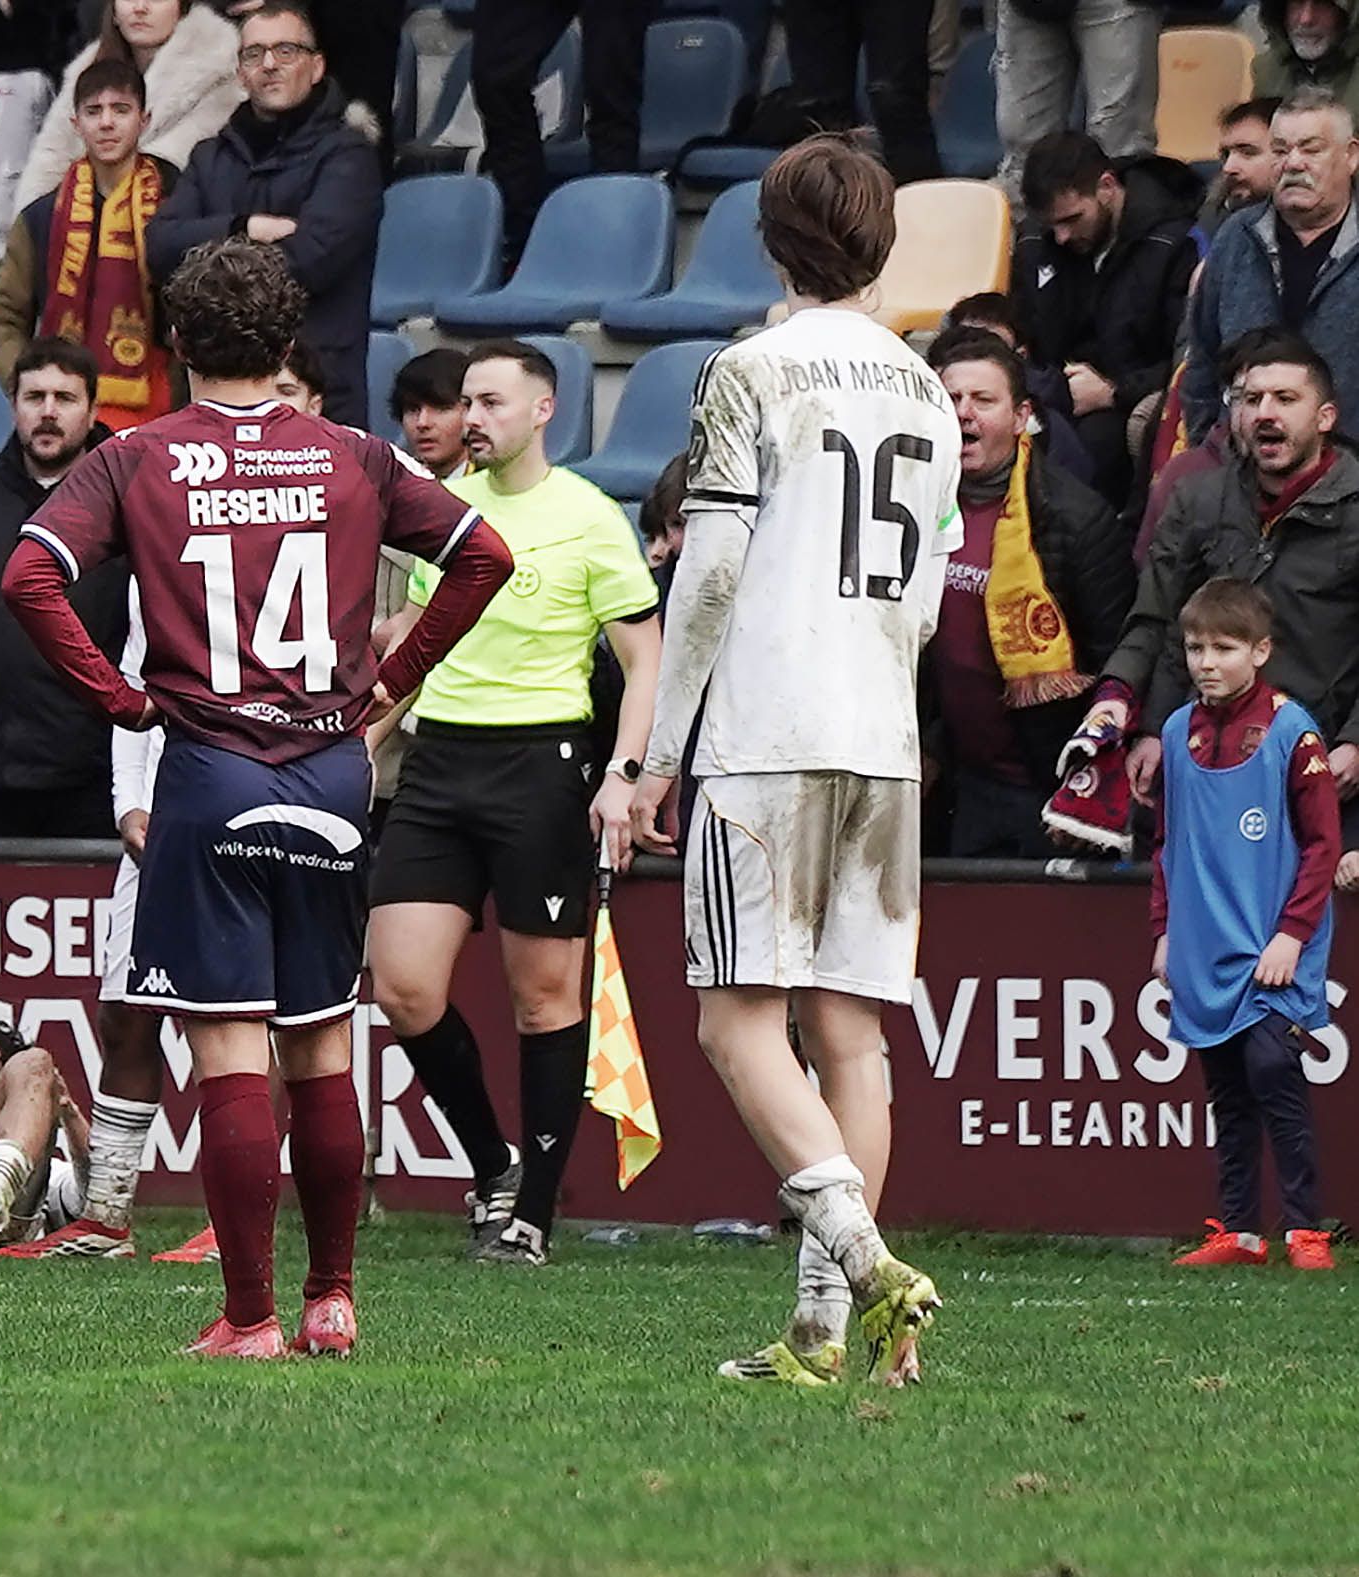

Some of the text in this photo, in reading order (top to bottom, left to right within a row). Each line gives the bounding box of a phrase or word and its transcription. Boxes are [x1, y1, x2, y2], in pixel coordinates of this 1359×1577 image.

[56, 231, 92, 297] VILA
[778, 357, 842, 396] JOAN
[233, 445, 332, 465] Deputación
[234, 461, 334, 478] Pontevedra
[187, 484, 329, 527] RESENDE
[822, 429, 934, 602] 15
[179, 531, 339, 694] 14
